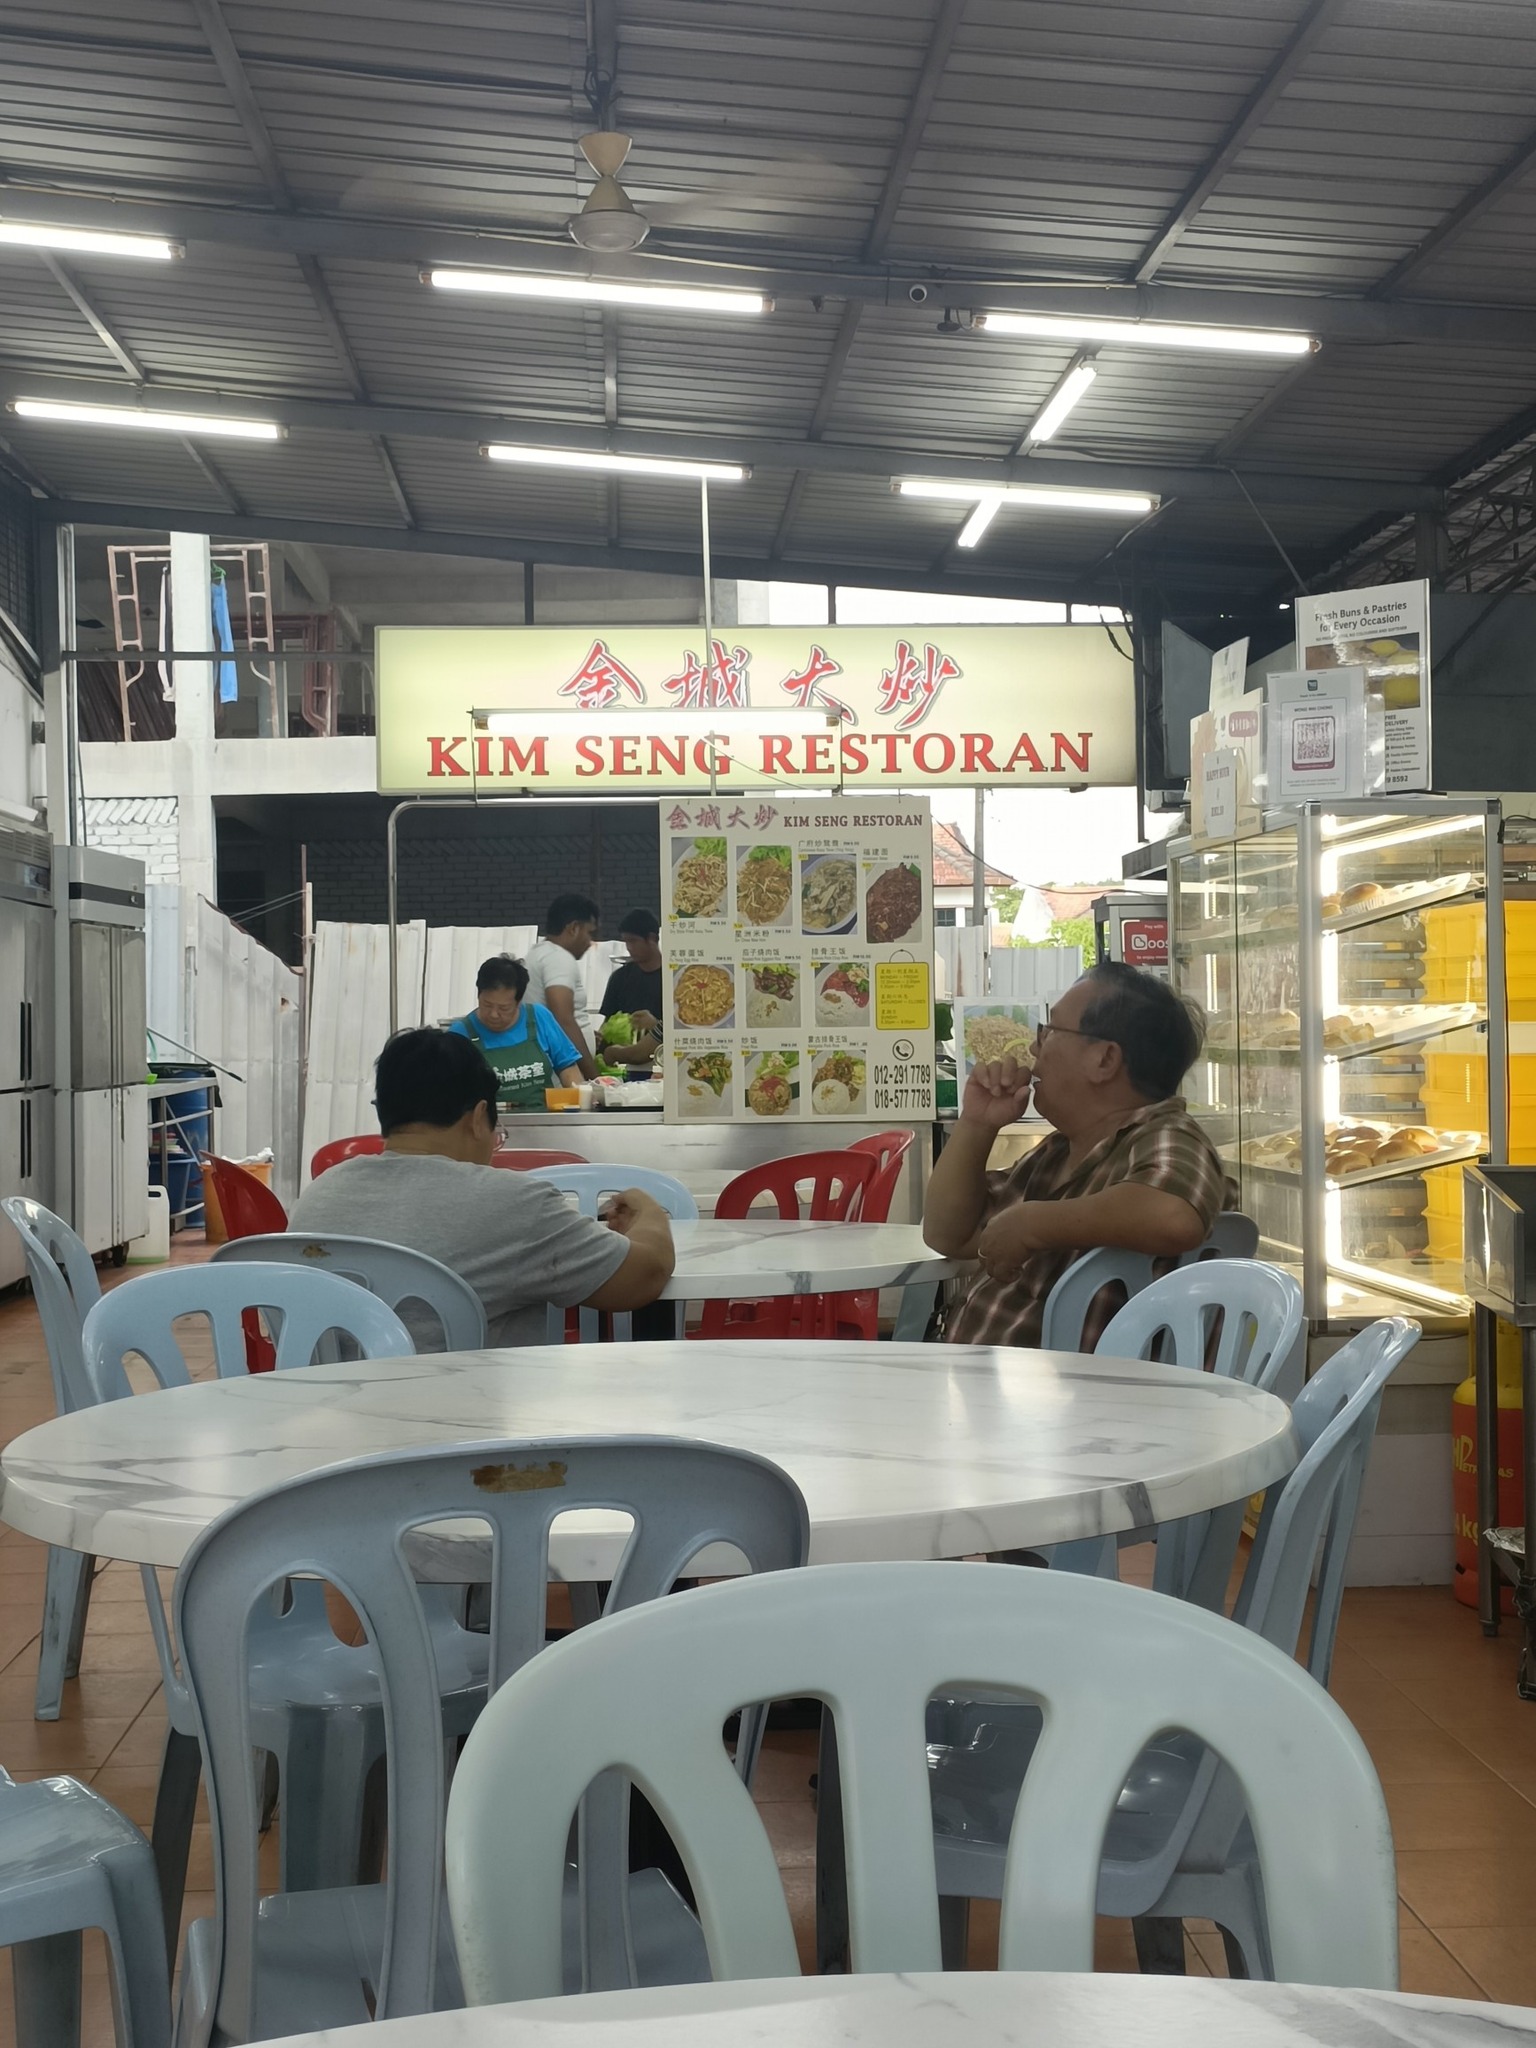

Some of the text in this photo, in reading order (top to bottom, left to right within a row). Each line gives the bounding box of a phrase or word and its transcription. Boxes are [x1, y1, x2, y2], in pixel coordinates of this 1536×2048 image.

[1340, 608, 1361, 618] Buns
[1363, 606, 1370, 615] &
[1372, 601, 1407, 614] Pastries
[1334, 620, 1357, 631] Every
[1360, 614, 1400, 627] Occasion
[558, 639, 963, 730] 金城大炒
[427, 732, 1093, 776] KIM SENG RESTORAN
[1392, 775, 1408, 783] 8592
[666, 804, 779, 831] 金城大炒
[783, 814, 923, 828] KIM SENG RESTORAN
[874, 1064, 931, 1084] 012-291 7789
[874, 1088, 931, 1108] 018-577 7789
